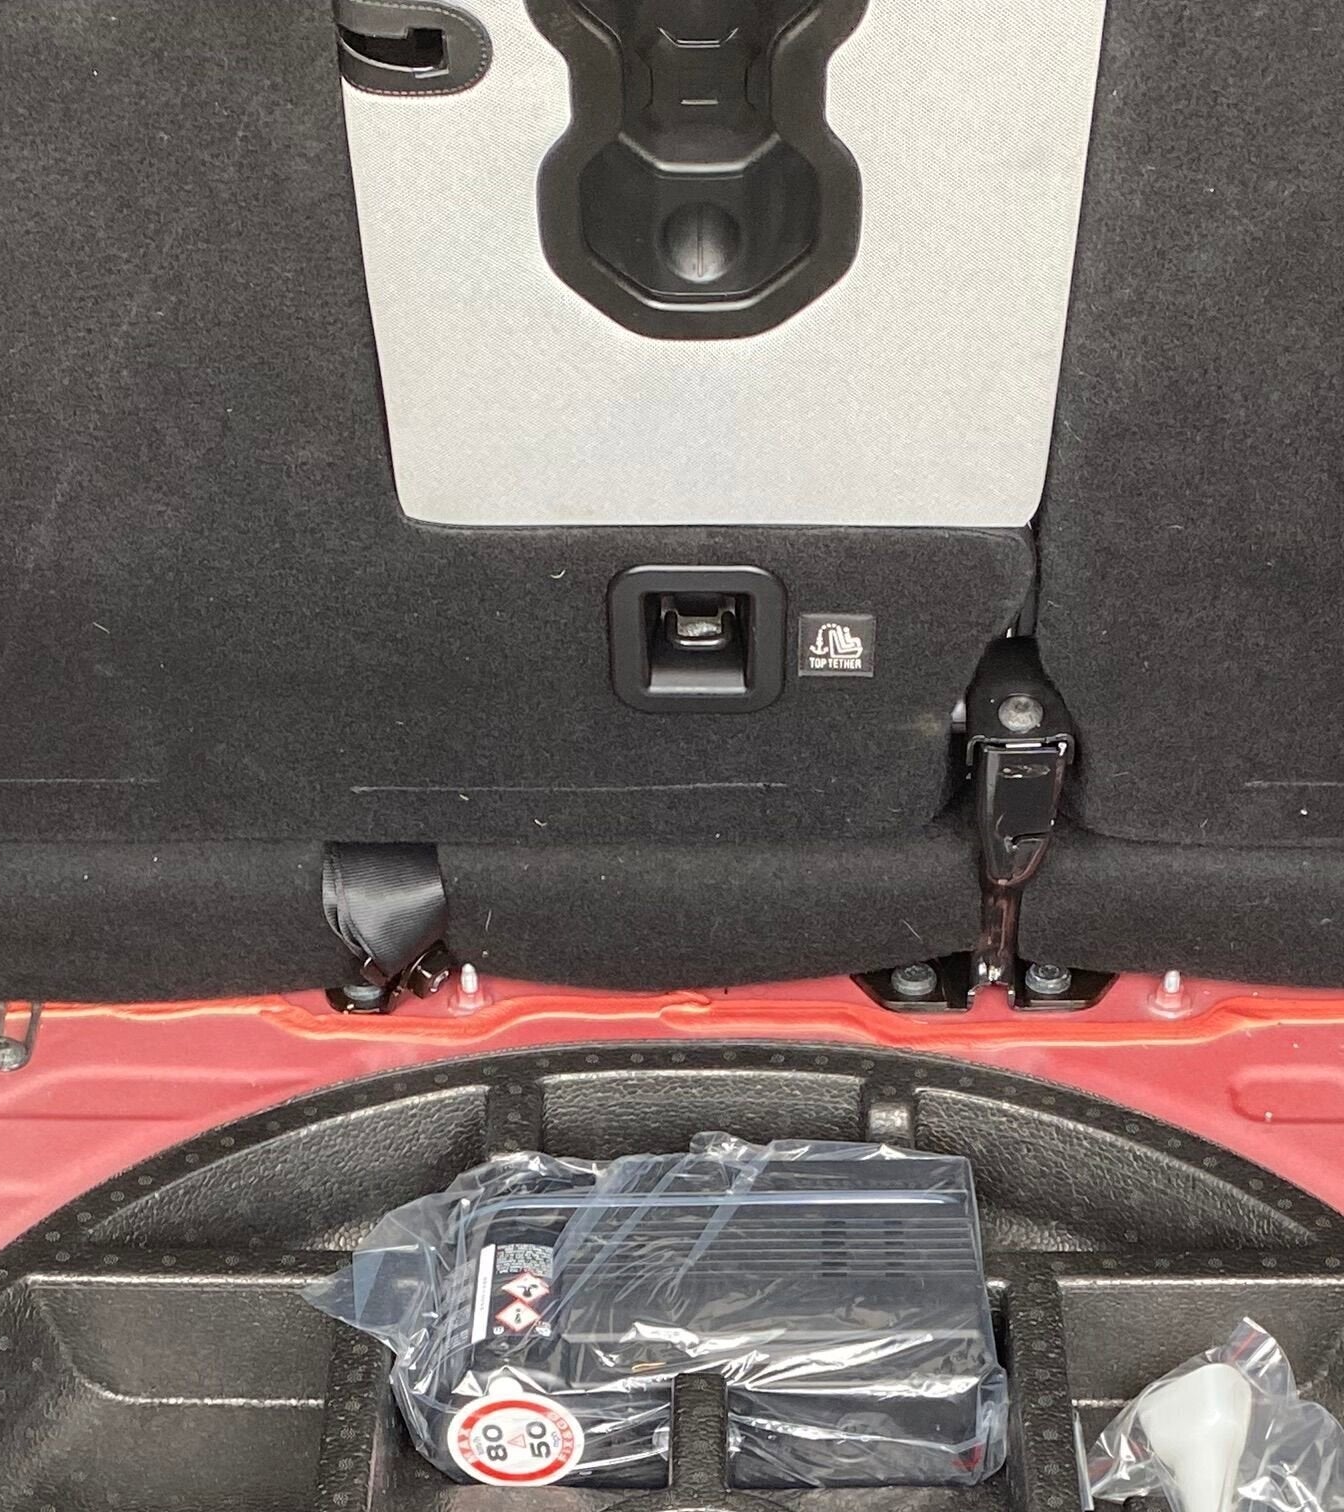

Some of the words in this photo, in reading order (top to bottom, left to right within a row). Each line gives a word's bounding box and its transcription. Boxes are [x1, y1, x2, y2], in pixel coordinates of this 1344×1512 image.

[809, 657, 827, 669] TOP
[828, 658, 862, 669] TETHER
[457, 1428, 479, 1463] MAX
[482, 1424, 508, 1461] 80
[526, 1421, 552, 1459] 50
